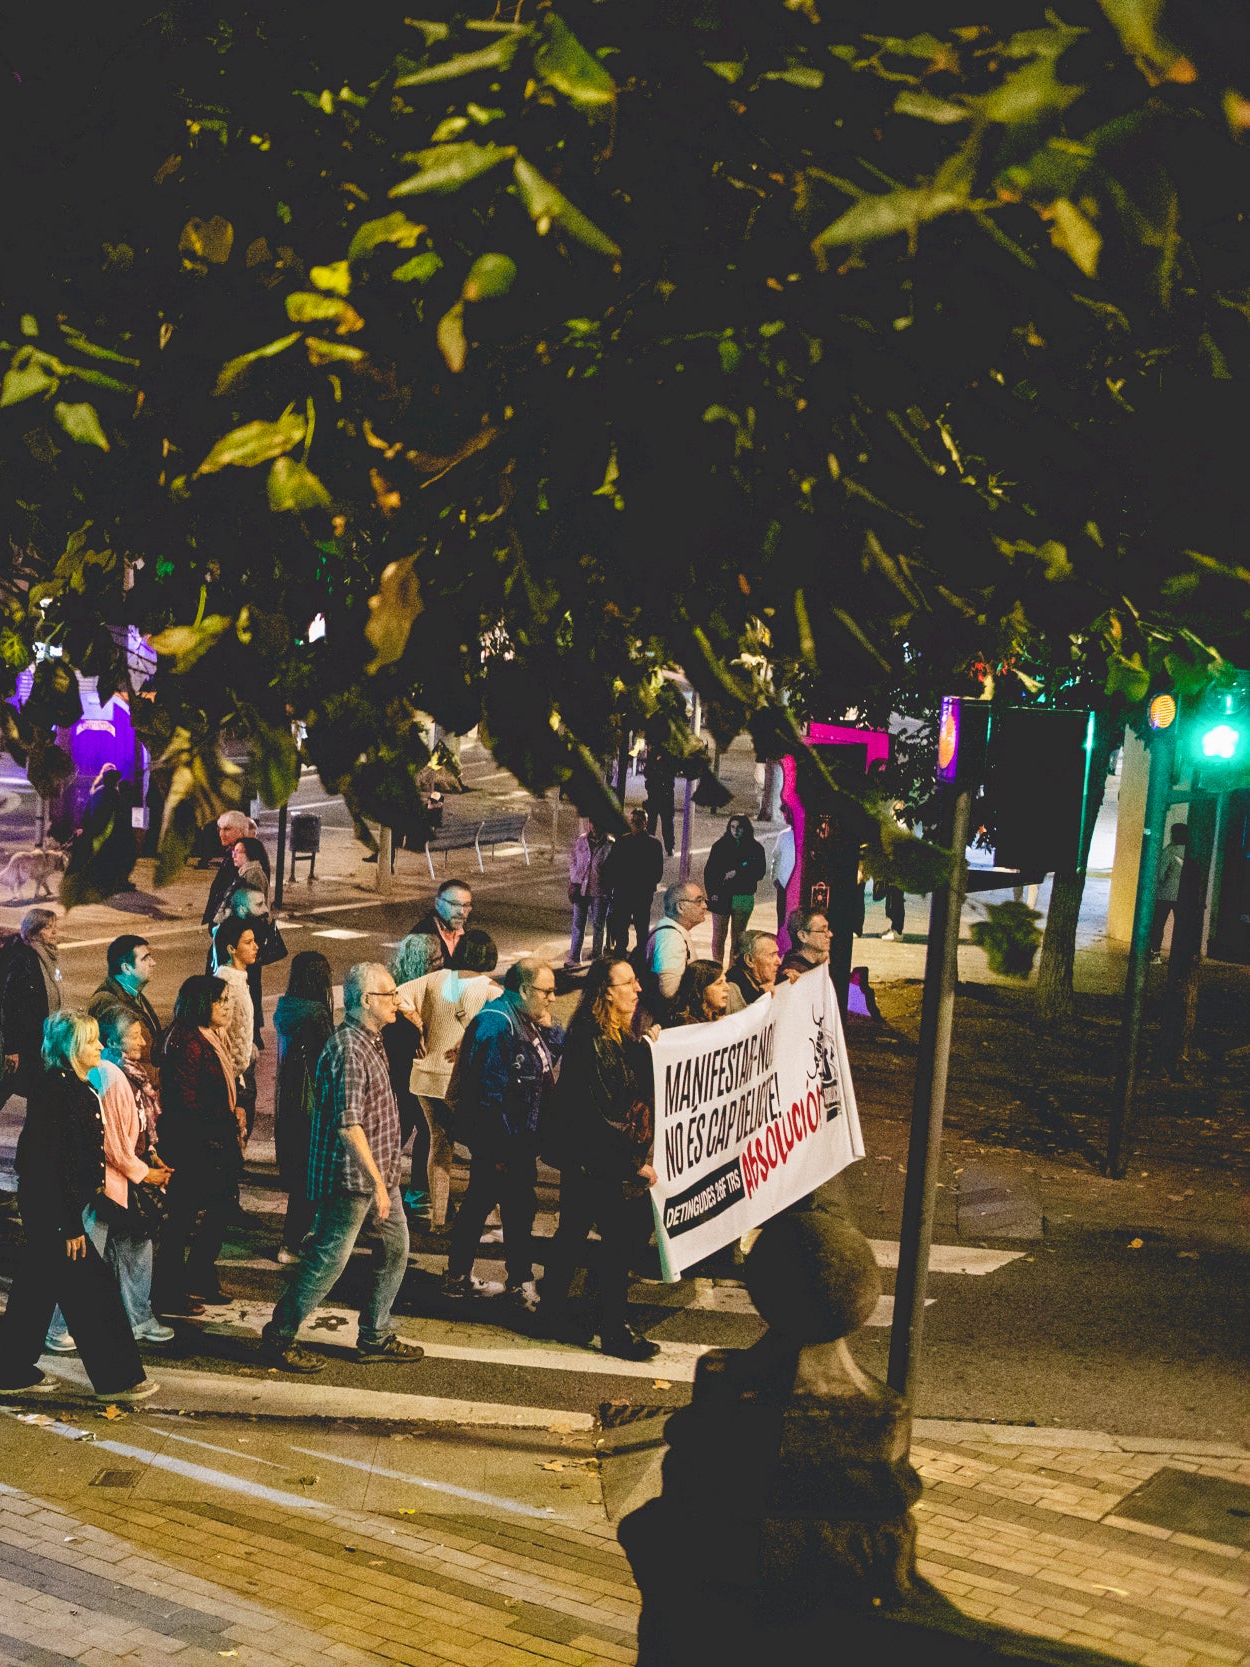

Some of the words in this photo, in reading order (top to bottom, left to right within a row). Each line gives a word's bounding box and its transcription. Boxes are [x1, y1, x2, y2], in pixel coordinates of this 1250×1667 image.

[665, 1121, 684, 1182] NO
[686, 1104, 706, 1169] ÉS
[706, 1100, 737, 1158] CAP
[735, 1071, 782, 1144] DELICTE!
[666, 1184, 717, 1229] DETINGUDES
[725, 1168, 741, 1194] TRS
